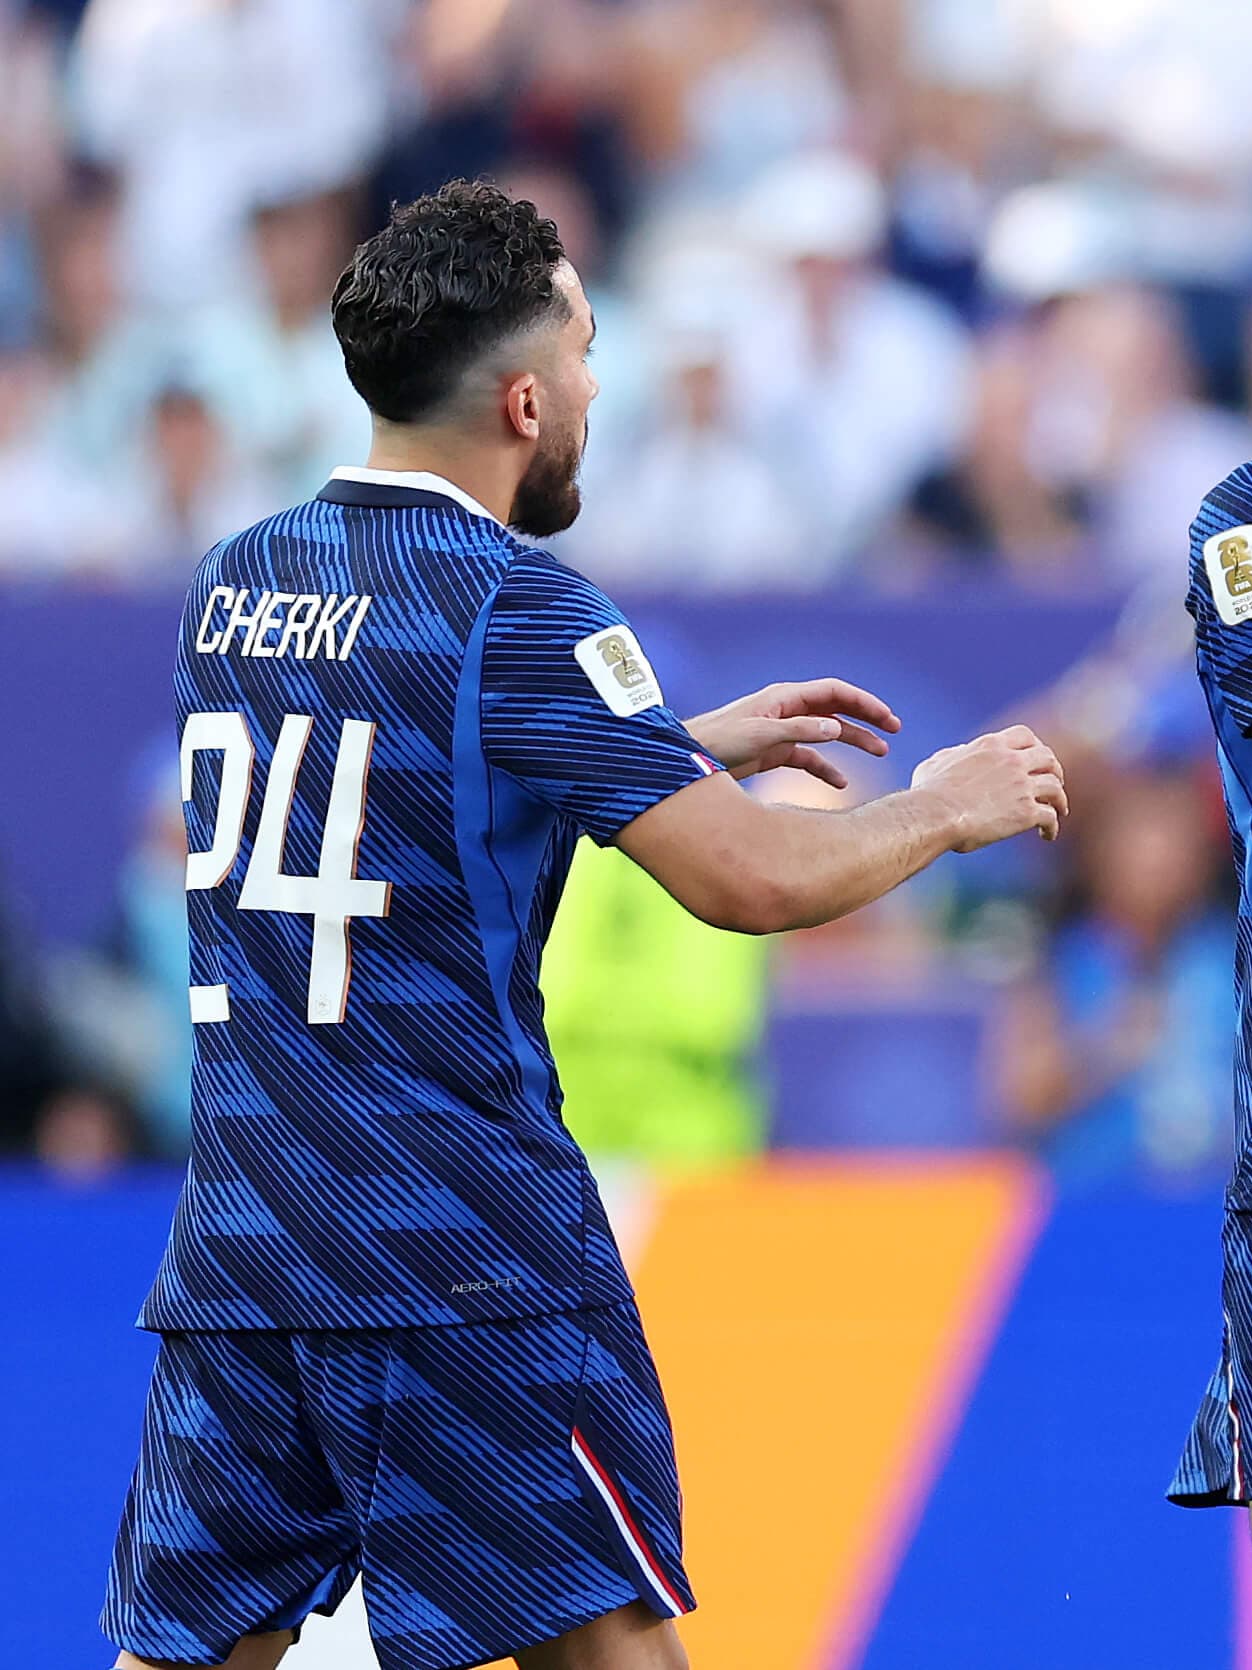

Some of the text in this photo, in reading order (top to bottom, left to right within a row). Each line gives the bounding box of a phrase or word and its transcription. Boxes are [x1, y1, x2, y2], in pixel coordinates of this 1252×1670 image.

[196, 585, 372, 661] CHERKI
[180, 711, 393, 1024] 24
[450, 1276, 521, 1294] AERO-FIT
